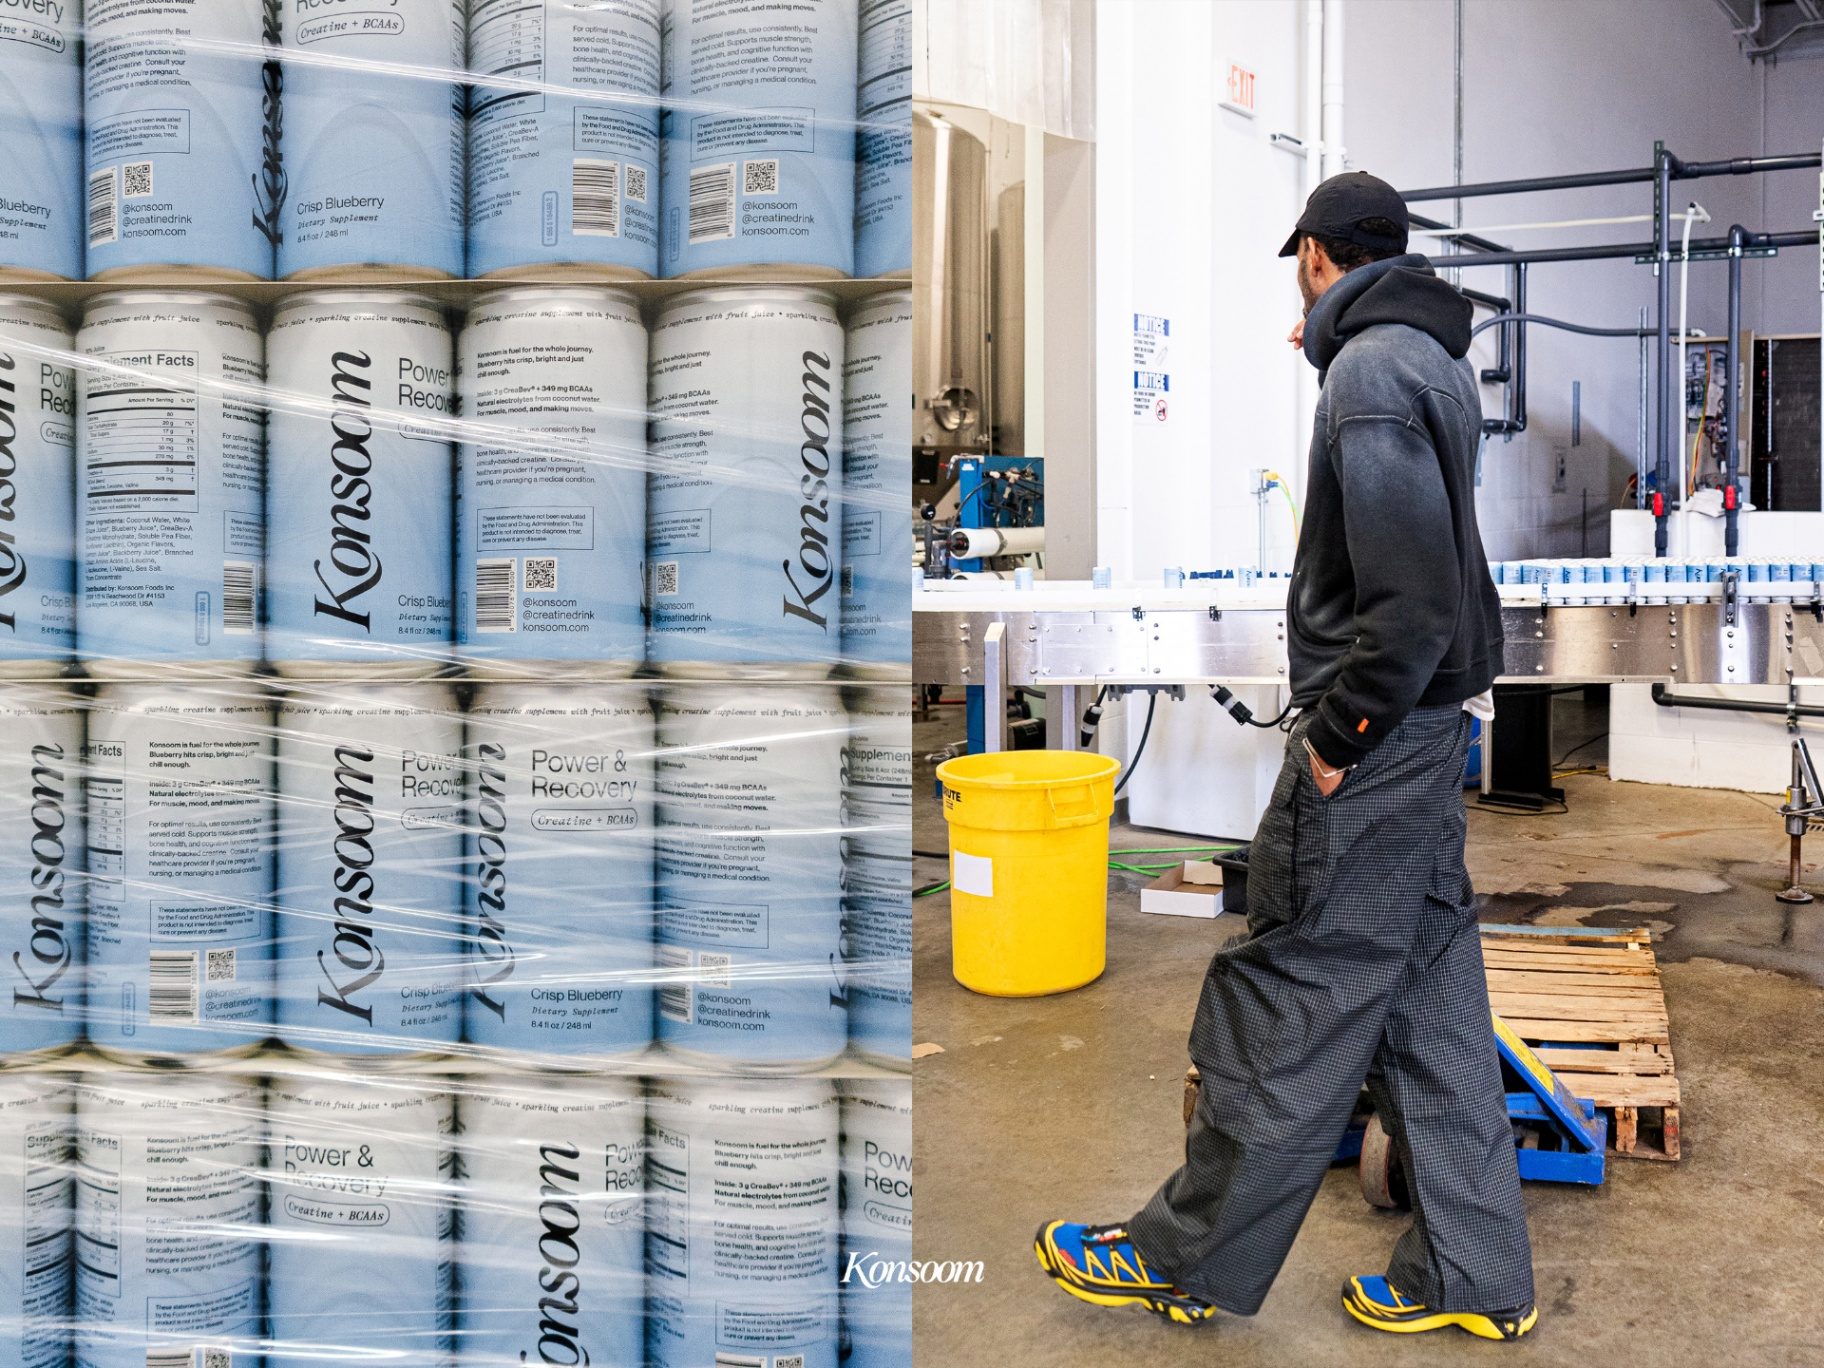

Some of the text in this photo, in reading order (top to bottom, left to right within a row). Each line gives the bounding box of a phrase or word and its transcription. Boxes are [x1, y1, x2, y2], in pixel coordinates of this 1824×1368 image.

[766, 3, 792, 11] making
[300, 21, 347, 39] Creatine
[363, 19, 399, 30] BCAAs
[32, 30, 61, 48] BCAAs
[727, 36, 758, 45] Supports
[759, 35, 783, 43] muscle
[773, 45, 798, 53] function
[773, 55, 798, 63] Consult
[761, 76, 786, 84] medical
[123, 202, 173, 213] @konsoom
[297, 196, 384, 216] Crisp Blueberry
[742, 201, 798, 212] @konsoom
[123, 214, 192, 226] @creatinedrink
[298, 214, 379, 230] Dietary Supplement
[742, 213, 815, 224] @creatinedrink
[123, 228, 186, 238] konsoom.com
[742, 226, 809, 236] konsoom.com
[315, 315, 350, 323] sparkling
[726, 311, 748, 320] fruit
[157, 354, 194, 366] Facts
[536, 355, 556, 363] bright
[399, 357, 448, 386] Power
[399, 384, 448, 411] Recov
[544, 405, 569, 413] making
[314, 350, 382, 634] Konsoom
[783, 351, 833, 636] Konsoom
[398, 595, 426, 610] Crisp
[523, 598, 577, 607] @konsoom
[399, 613, 427, 622] Dietary
[523, 610, 595, 620] @creatinedrink
[523, 623, 589, 632] konsoom.com
[591, 707, 611, 717] fruit
[782, 708, 801, 717] fruit
[98, 744, 122, 757] Facts
[149, 751, 182, 759] Blueberry
[532, 750, 627, 772] Power &
[402, 776, 461, 798] Recove
[532, 776, 637, 801] Recovery
[944, 787, 962, 803] UTE
[538, 815, 592, 826] Creatine
[607, 814, 634, 825] BCAAs
[183, 869, 214, 877] managing
[13, 743, 71, 1017] Konsoom
[317, 744, 385, 1028] Konsoom
[401, 985, 430, 1000] Crisp
[531, 988, 623, 1003] Crisp Blueberry
[698, 992, 751, 1005] @konsoom
[532, 1007, 618, 1016] Dietary Supplement
[698, 1005, 771, 1019] @creatinedrink
[698, 1017, 765, 1031] konsoom.com
[522, 1104, 558, 1112] sparkling
[715, 1139, 748, 1148] Konsoom
[285, 1135, 374, 1167] Power &
[715, 1190, 782, 1200] Natural electrolytes
[288, 1201, 333, 1219] Creatine
[349, 1211, 384, 1221] BCAAs
